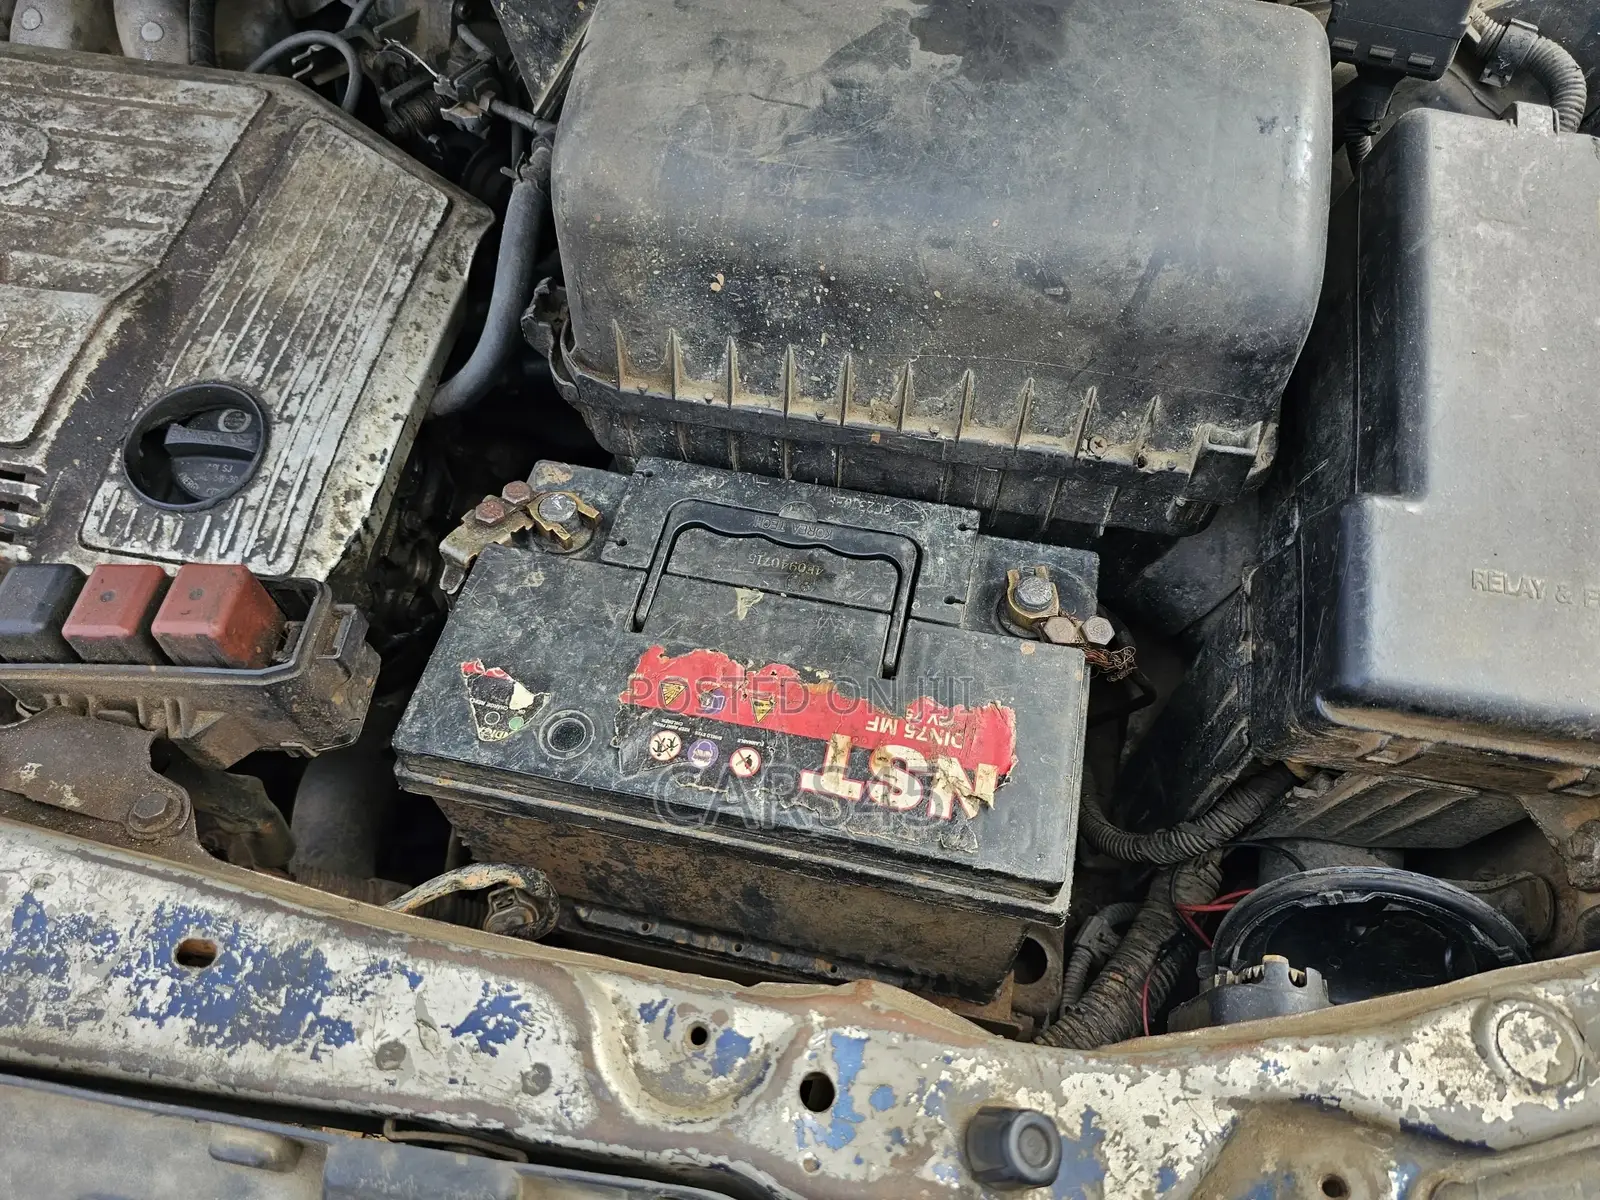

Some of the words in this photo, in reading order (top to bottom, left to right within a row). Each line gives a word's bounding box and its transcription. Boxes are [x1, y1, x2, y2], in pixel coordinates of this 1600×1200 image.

[752, 514, 786, 533] TECH
[791, 523, 833, 541] KOREA
[1471, 567, 1546, 600] RELAY
[1554, 584, 1574, 605] &
[864, 715, 899, 736] MF
[799, 733, 1000, 821] NST
